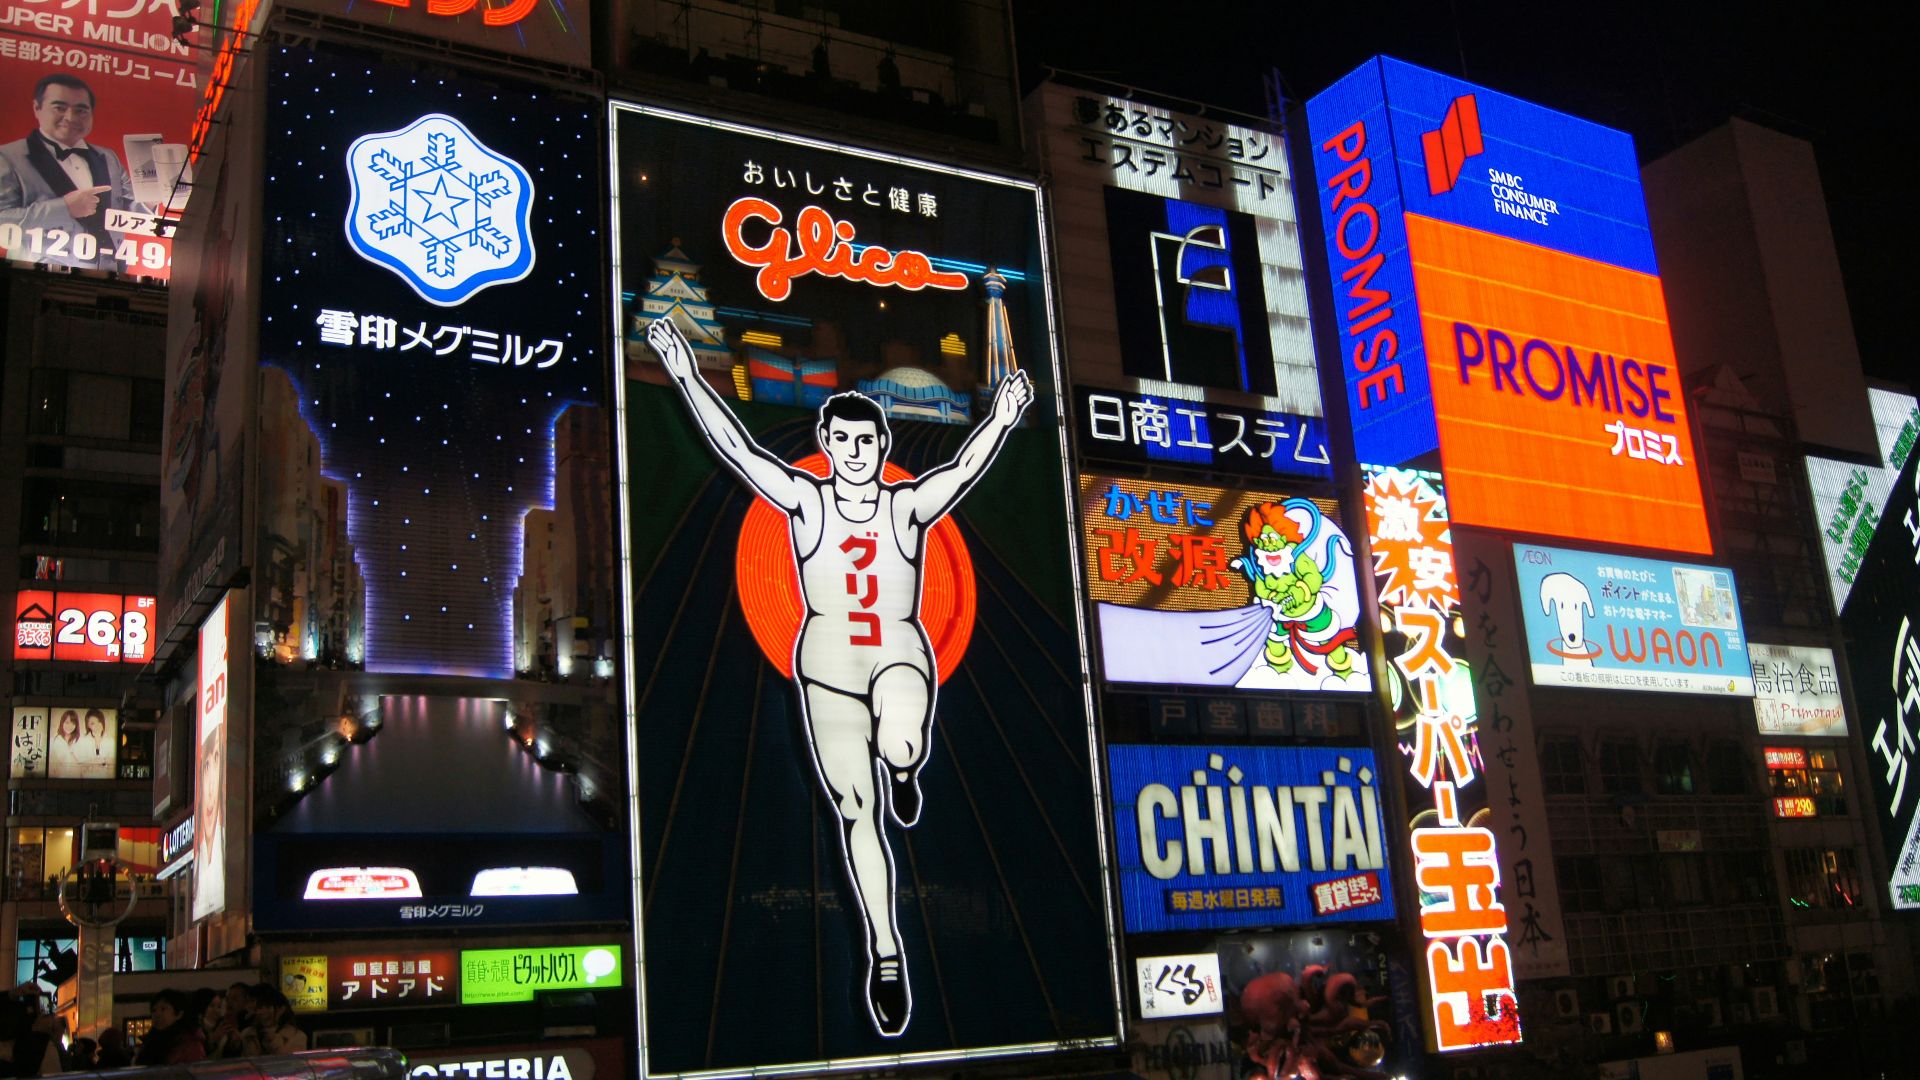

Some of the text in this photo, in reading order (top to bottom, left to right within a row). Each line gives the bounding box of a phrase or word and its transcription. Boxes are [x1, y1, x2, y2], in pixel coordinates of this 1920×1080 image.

[83, 21, 190, 57] MILLION
[743, 159, 939, 219] おいしさと健康
[1081, 137, 1274, 200] エステムコート
[1489, 168, 1523, 191] SMBC
[1491, 184, 1559, 215] CONSUMER
[1494, 200, 1549, 226] FINANCE
[0, 222, 172, 269] 0120-49
[723, 197, 969, 301] Glico
[1323, 120, 1405, 409] PROMISE
[316, 309, 564, 368] 雪印メグミルク
[1453, 321, 1676, 424] PROMISE
[1088, 394, 1331, 465] 日商エステム
[1604, 420, 1684, 466] プロミス
[1104, 484, 1215, 527] かぜに
[1094, 527, 1232, 591] 改源
[838, 531, 882, 647] グリコ
[18, 628, 51, 647] うちくる
[1607, 625, 1724, 669] WAON
[205, 672, 225, 715] an
[17, 715, 42, 730] 4F
[1137, 768, 1384, 880] CHINTAI
[400, 904, 484, 919] 雪印メグミルク
[1172, 888, 1281, 911] 毎週水曜日発売
[1315, 880, 1351, 913] 賃貸
[1352, 887, 1381, 905] ニュース
[341, 976, 446, 1000] アドアド
[353, 960, 431, 976] 個室居酒屋
[513, 953, 578, 985] ピタットハウス
